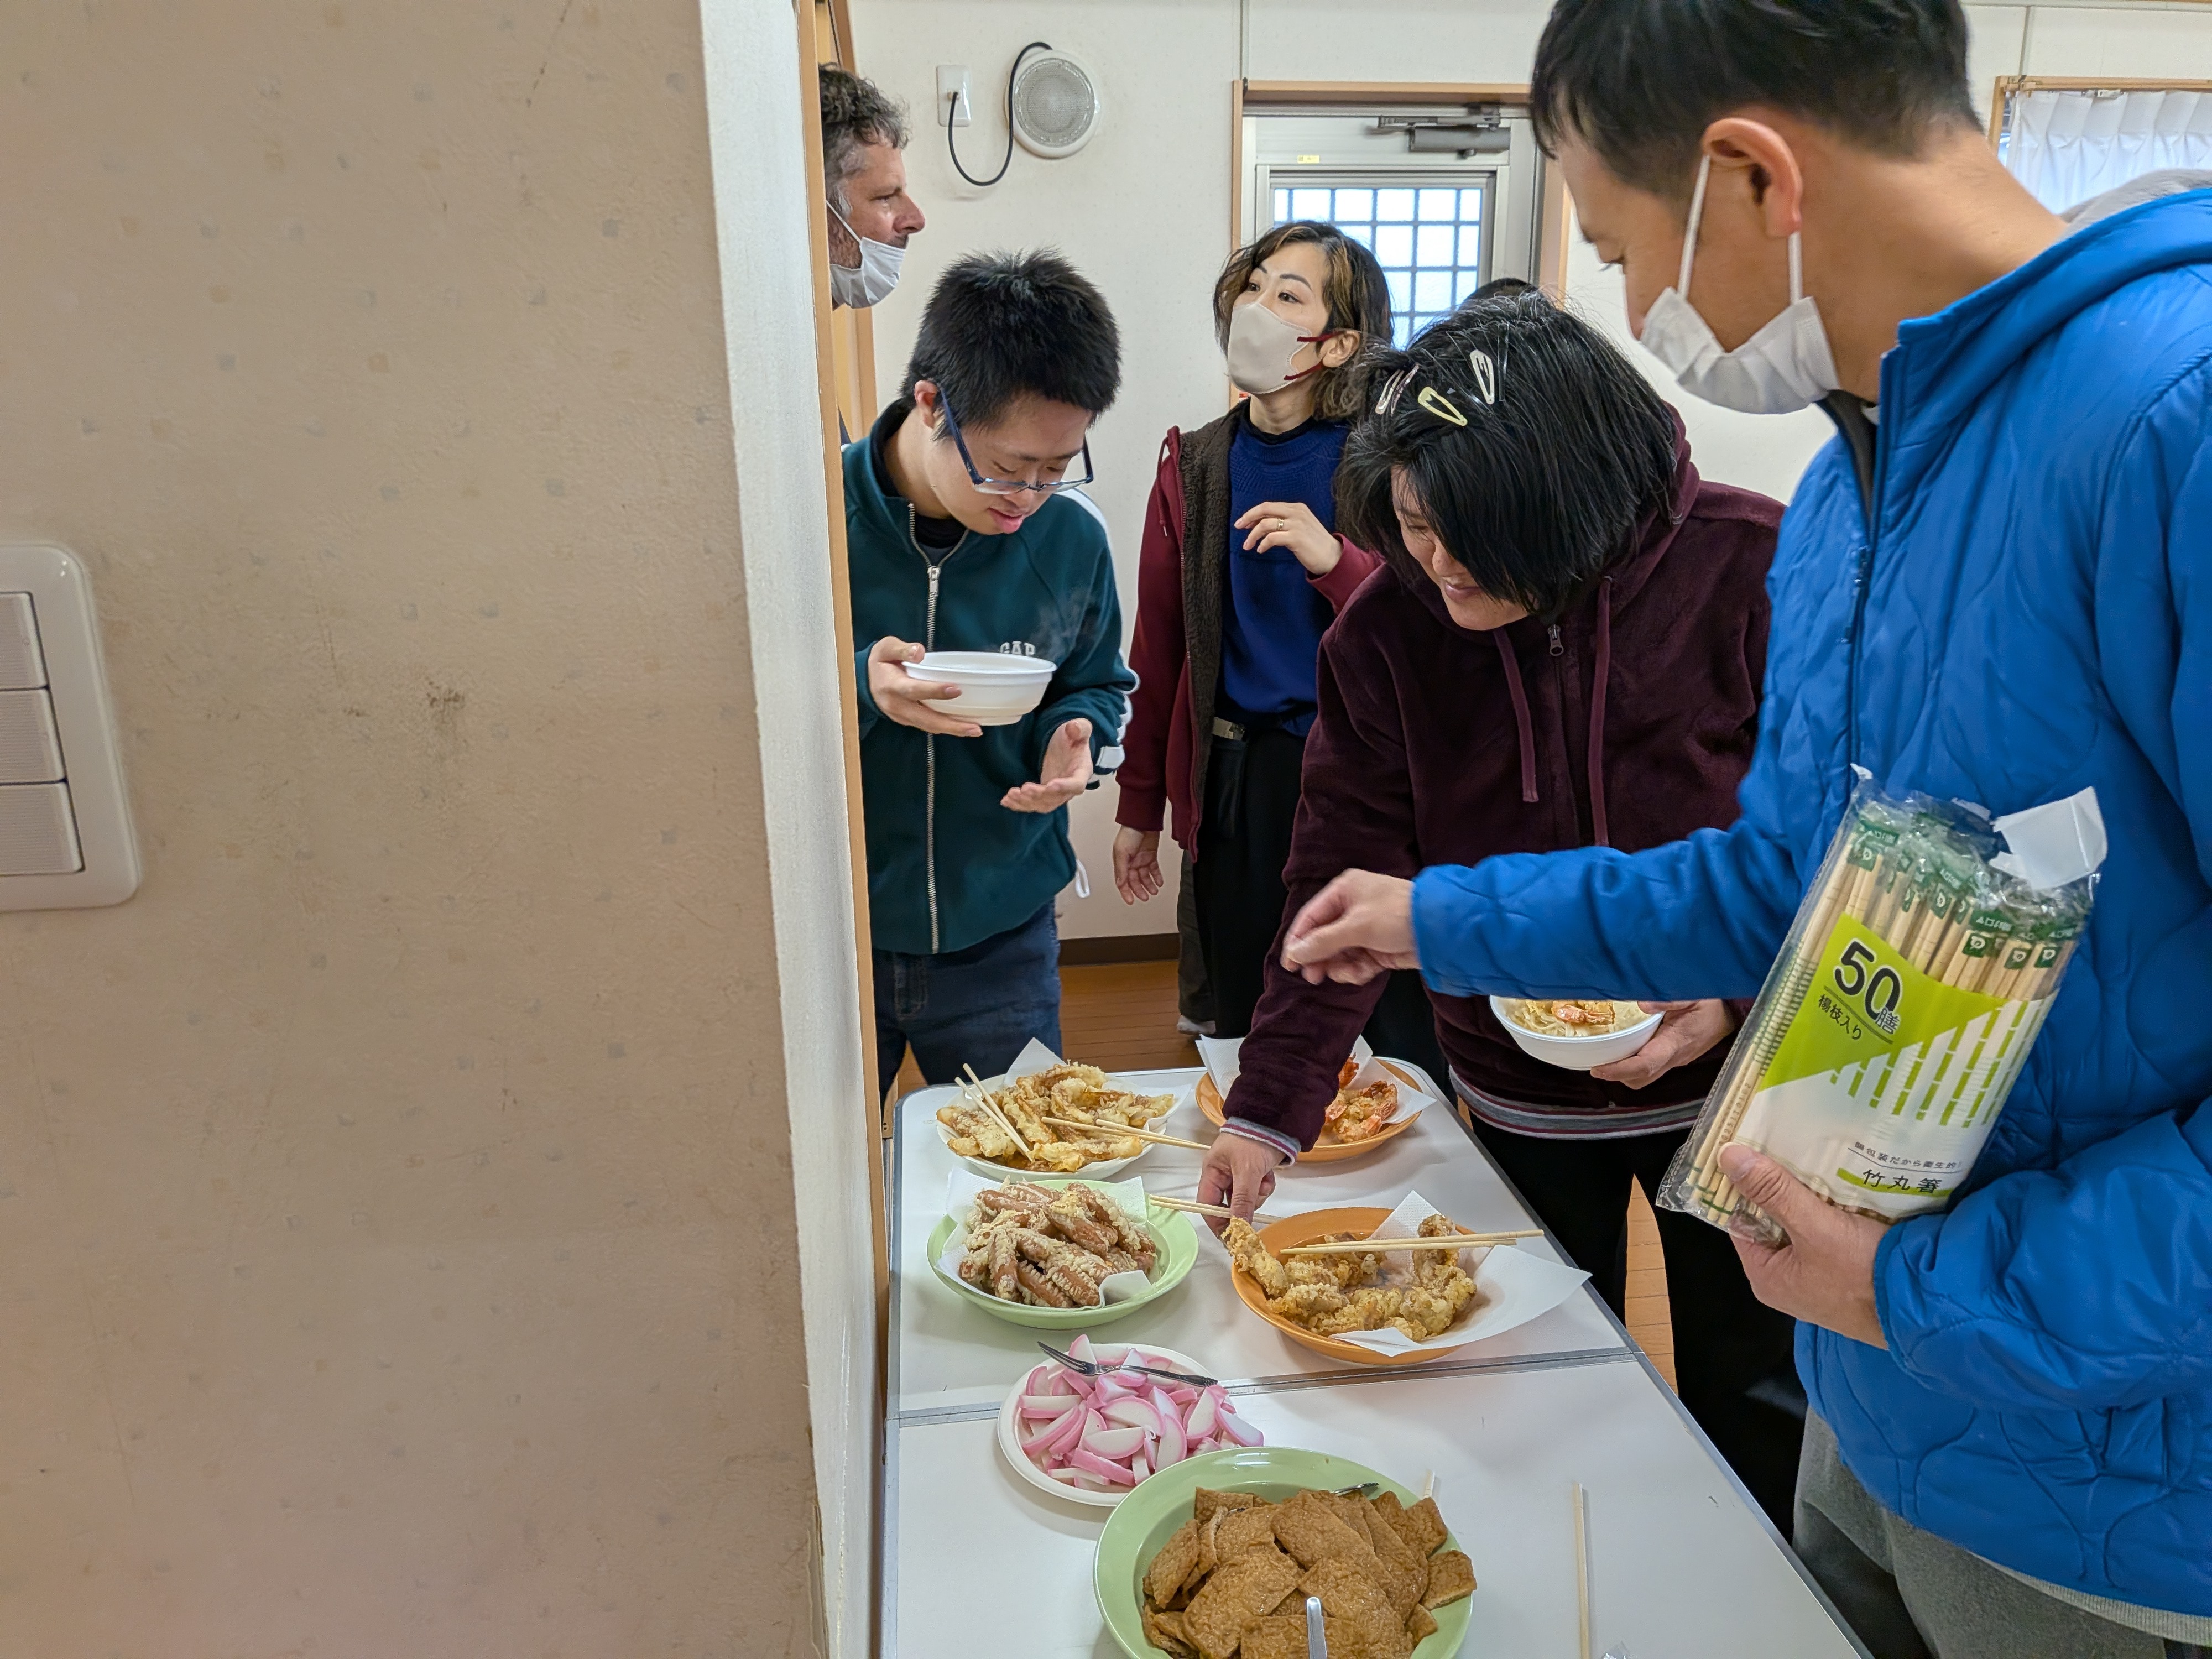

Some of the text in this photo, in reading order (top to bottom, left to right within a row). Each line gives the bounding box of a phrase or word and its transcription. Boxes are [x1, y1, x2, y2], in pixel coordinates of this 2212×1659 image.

[999, 641, 1036, 656] GAP
[1818, 994, 1862, 1040] 楊枝入り
[1863, 1169, 1942, 1193] 竹丸箸
